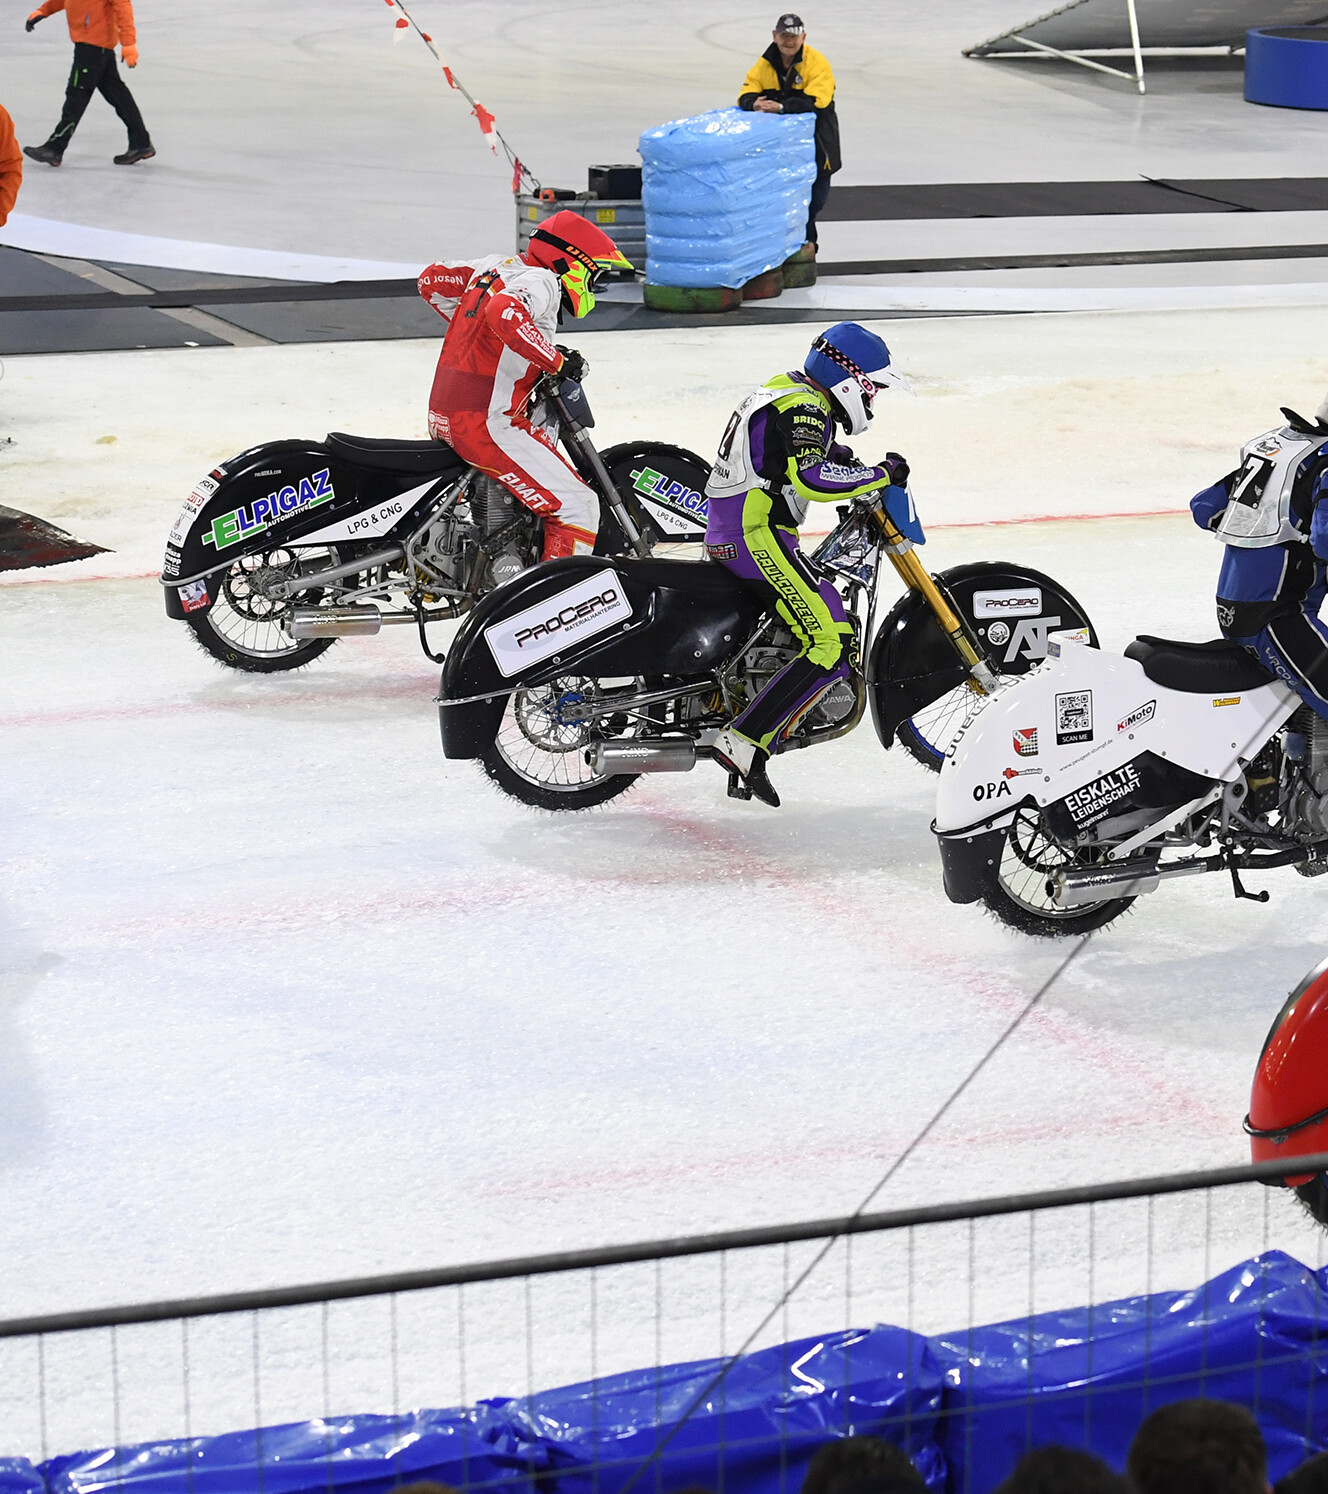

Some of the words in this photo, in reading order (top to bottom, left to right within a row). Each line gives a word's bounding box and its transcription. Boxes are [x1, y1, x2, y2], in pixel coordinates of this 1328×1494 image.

[632, 466, 708, 516] ELPIGA
[1234, 456, 1265, 500] 7
[211, 467, 335, 550] ELPIGAZ
[267, 503, 311, 528] AUTOMOTIVE
[347, 517, 370, 535] LPG
[371, 513, 379, 524] &
[379, 502, 403, 520] CNG
[656, 510, 669, 521] LPG
[675, 517, 688, 530] CNG
[564, 601, 621, 633] MATERIALHANTERING
[823, 694, 852, 704] JAWA
[1062, 735, 1078, 743] SCAN
[973, 780, 1012, 801] OPA
[1071, 778, 1141, 822] LEIDENSCHAFT
